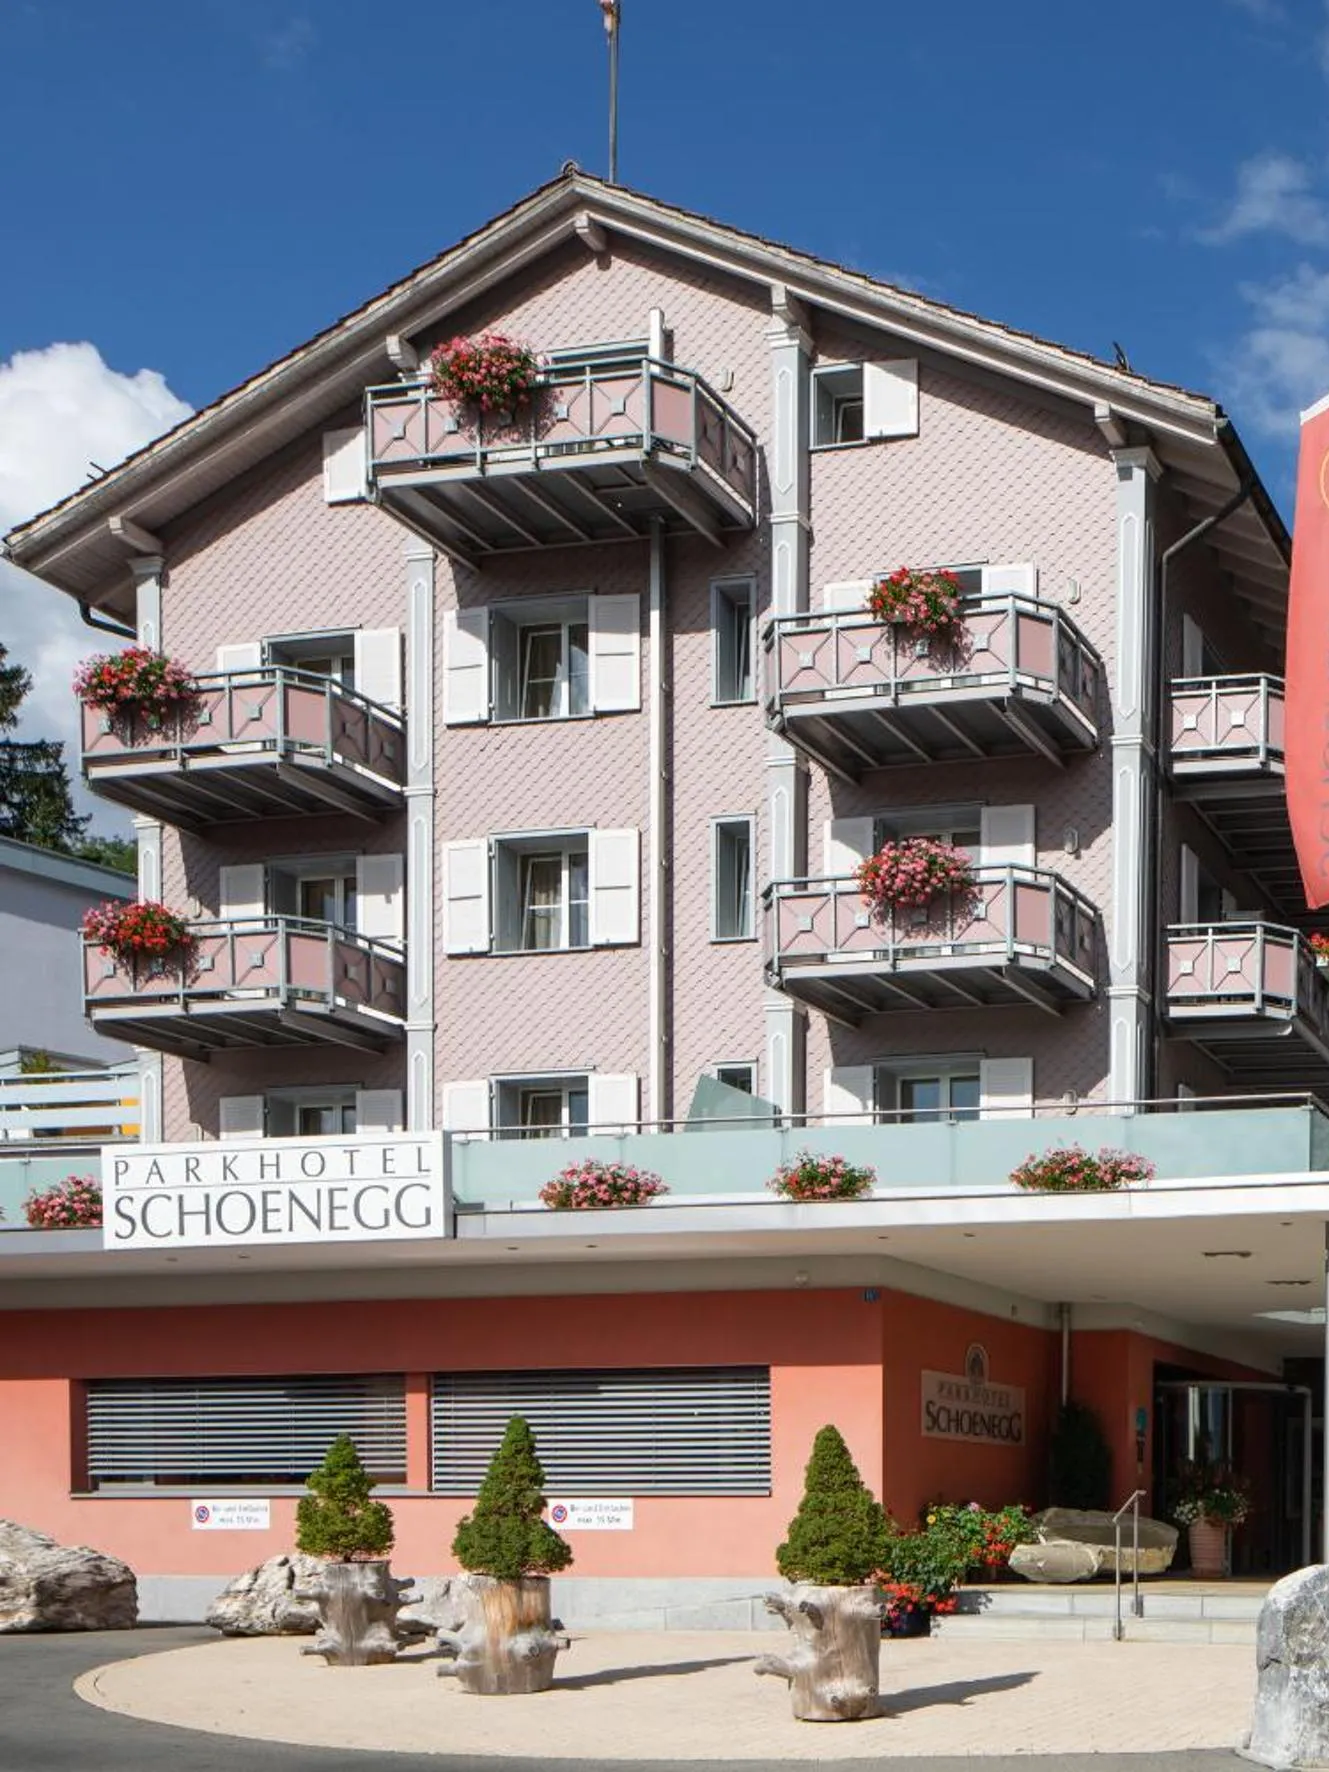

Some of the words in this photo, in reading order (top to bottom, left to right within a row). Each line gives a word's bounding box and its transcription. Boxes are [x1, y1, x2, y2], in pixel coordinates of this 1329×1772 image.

[114, 1146, 431, 1186] PARKHOTEL
[114, 1183, 431, 1239] SCHOENEGG
[925, 1400, 1022, 1443] SCHOENEGG
